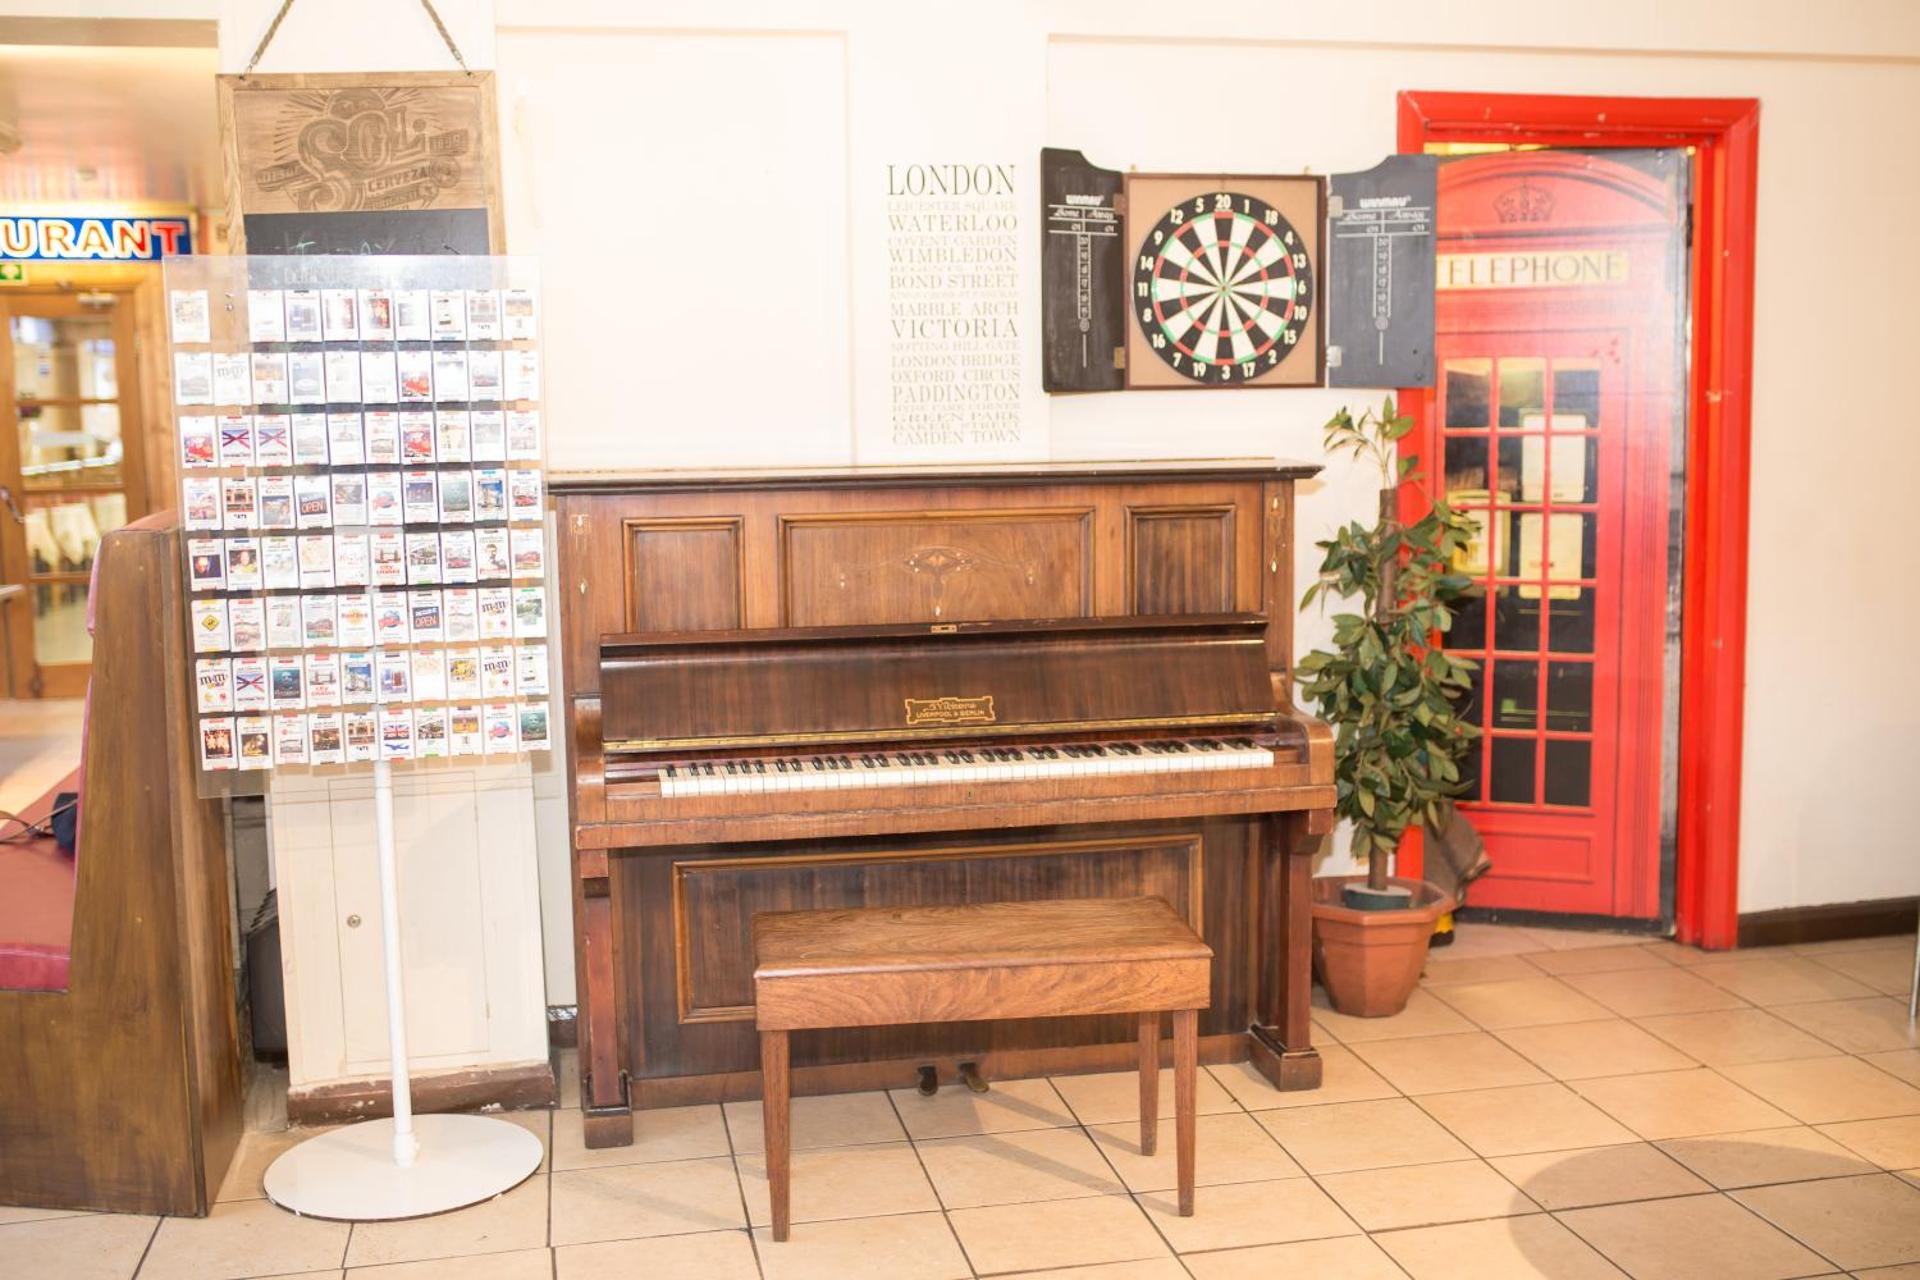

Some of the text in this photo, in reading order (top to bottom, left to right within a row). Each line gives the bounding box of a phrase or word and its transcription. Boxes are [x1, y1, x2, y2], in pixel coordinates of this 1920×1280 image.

[887, 164, 1015, 196] LONDON
[1195, 198, 1204, 213] 5
[1216, 194, 1231, 208] 20
[1244, 199, 1250, 213] 1
[888, 214, 1018, 232] WATERLOO
[1170, 209, 1184, 225] 12
[1265, 210, 1278, 226] 18
[1154, 230, 1163, 245] 9
[1284, 230, 1294, 245] 4
[889, 248, 1017, 263] WIMBLEDON
[1140, 256, 1154, 270] 14
[1293, 254, 1306, 268] 13
[890, 273, 1018, 289] BOND STREET
[1298, 281, 1306, 295] 6
[1138, 282, 1149, 296] 11
[891, 301, 1018, 316] MARBLE ARCH
[1143, 308, 1152, 322] 8
[1294, 306, 1307, 320] 10
[891, 319, 1019, 338] VICTORIA
[1152, 333, 1166, 349] 16
[1283, 330, 1296, 344] 15
[892, 353, 1020, 368] LONDON BRIDGE
[1173, 352, 1182, 367] 7
[1268, 350, 1277, 364] 2
[891, 369, 1021, 383] OXFORD CIRCUS
[1192, 362, 1206, 377] 19
[1221, 366, 1231, 380] 3
[1242, 362, 1255, 377] 17
[892, 384, 1019, 403] PADDINGTON
[892, 429, 1020, 445] CAMDEN TOWN
